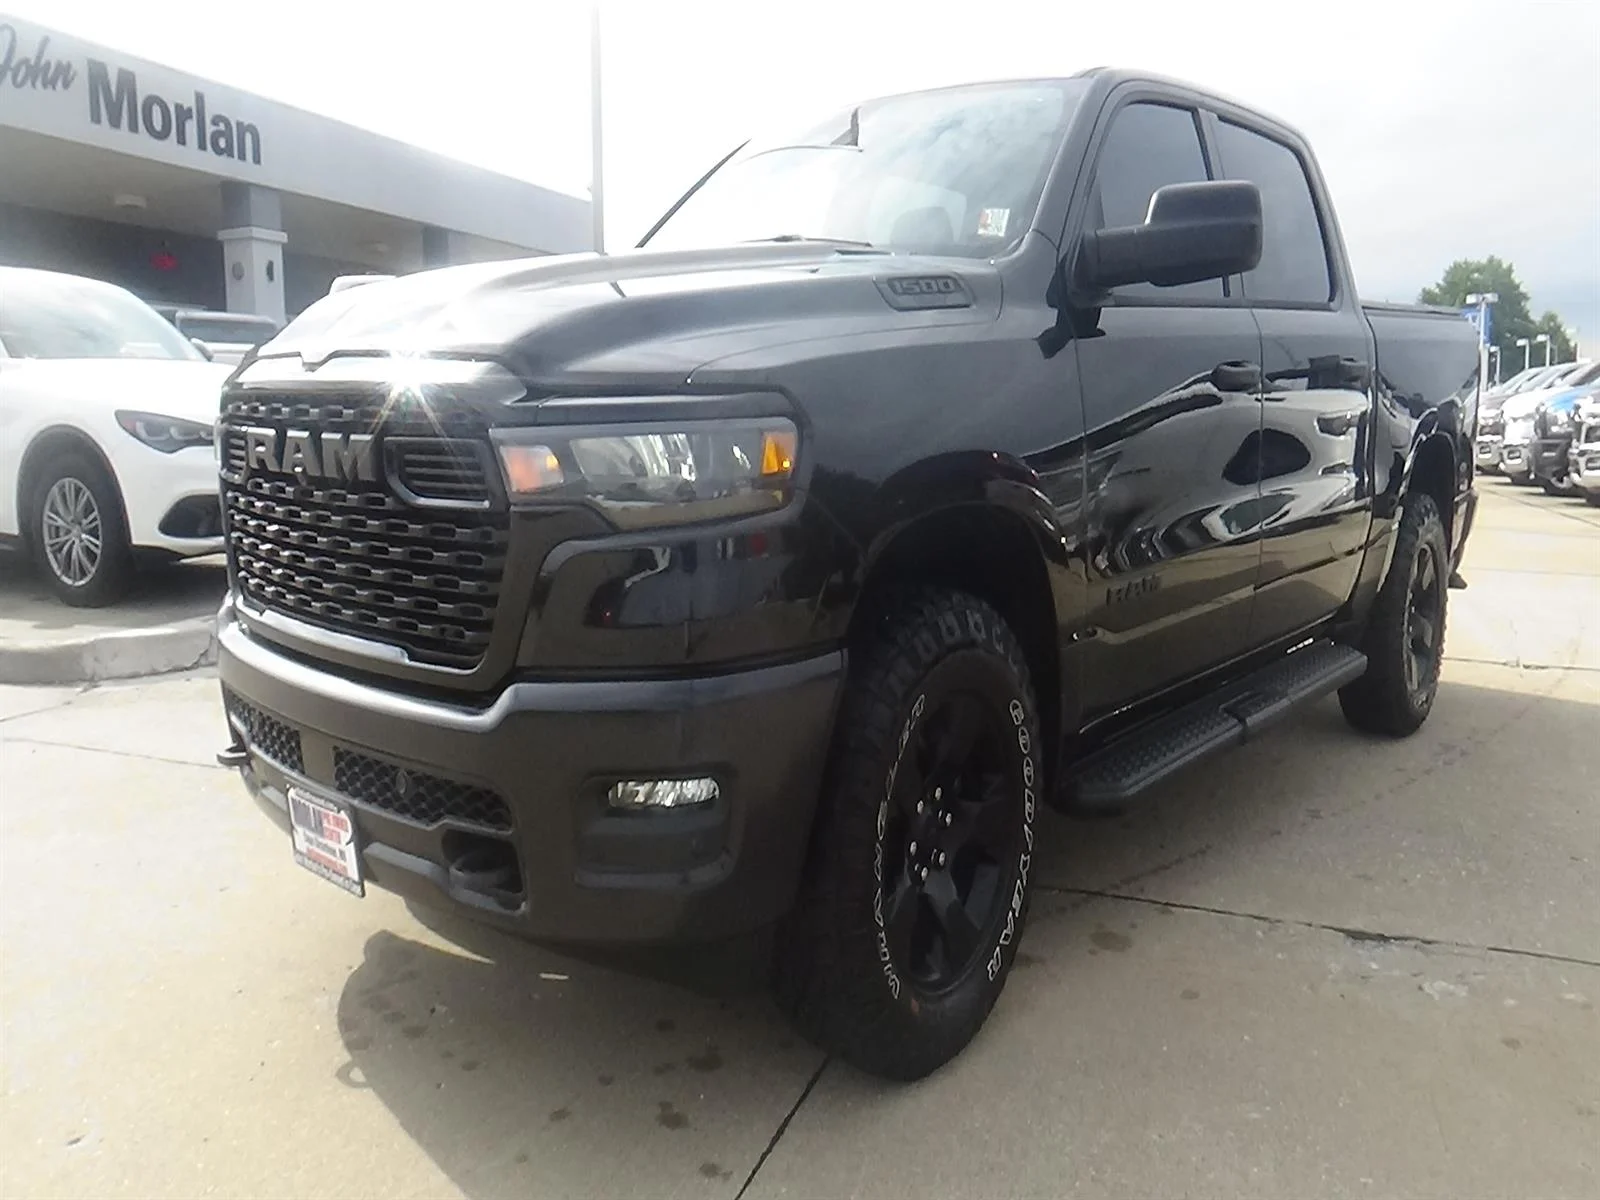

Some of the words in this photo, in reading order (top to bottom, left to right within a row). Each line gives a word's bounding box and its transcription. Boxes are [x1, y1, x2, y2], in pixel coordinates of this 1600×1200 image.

[0, 23, 77, 91] John
[86, 57, 262, 166] Morlan
[892, 279, 956, 294] 1500
[246, 425, 377, 481] RAM
[987, 699, 1035, 982] GOODYEAR
